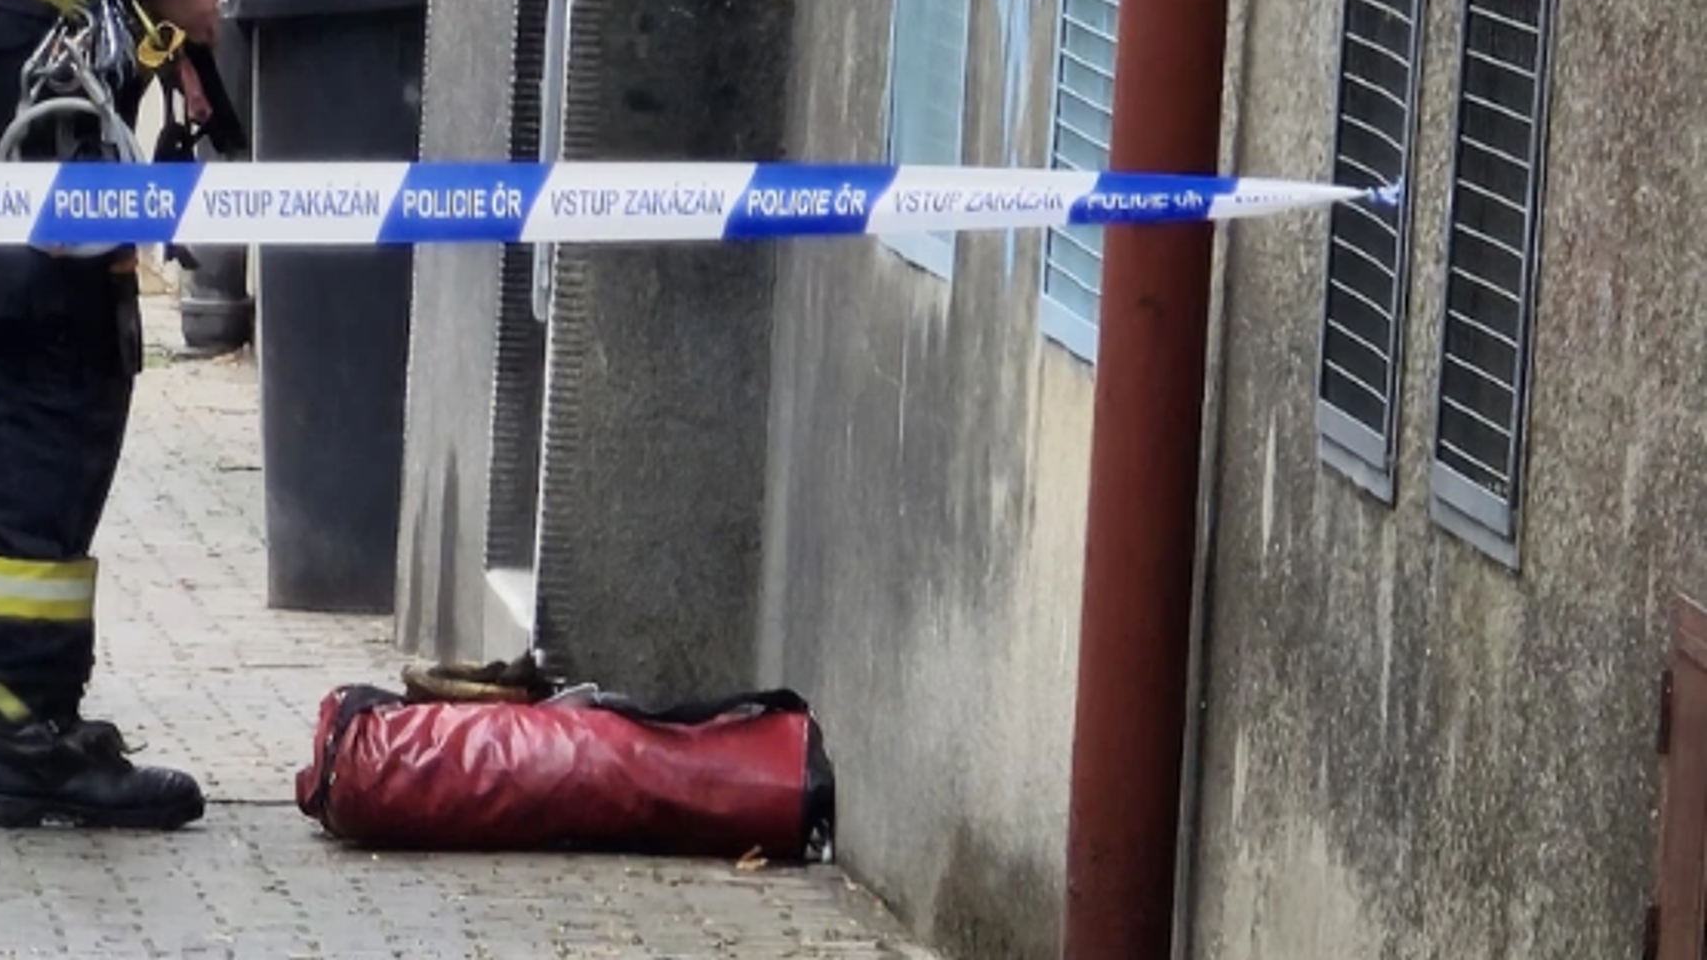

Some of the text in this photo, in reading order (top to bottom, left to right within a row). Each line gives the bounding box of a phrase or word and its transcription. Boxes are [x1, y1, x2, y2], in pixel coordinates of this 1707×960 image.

[55, 189, 139, 218] POLICIE
[144, 183, 176, 218] ČR
[203, 189, 272, 217] VSTUP
[279, 183, 380, 217] ZAKÁZÁN
[403, 189, 485, 218] POLICIE
[492, 182, 522, 218] ČR
[551, 189, 618, 216] VSTUP
[623, 182, 725, 216] ZAKÁZÁN
[747, 188, 830, 216] POLICIE
